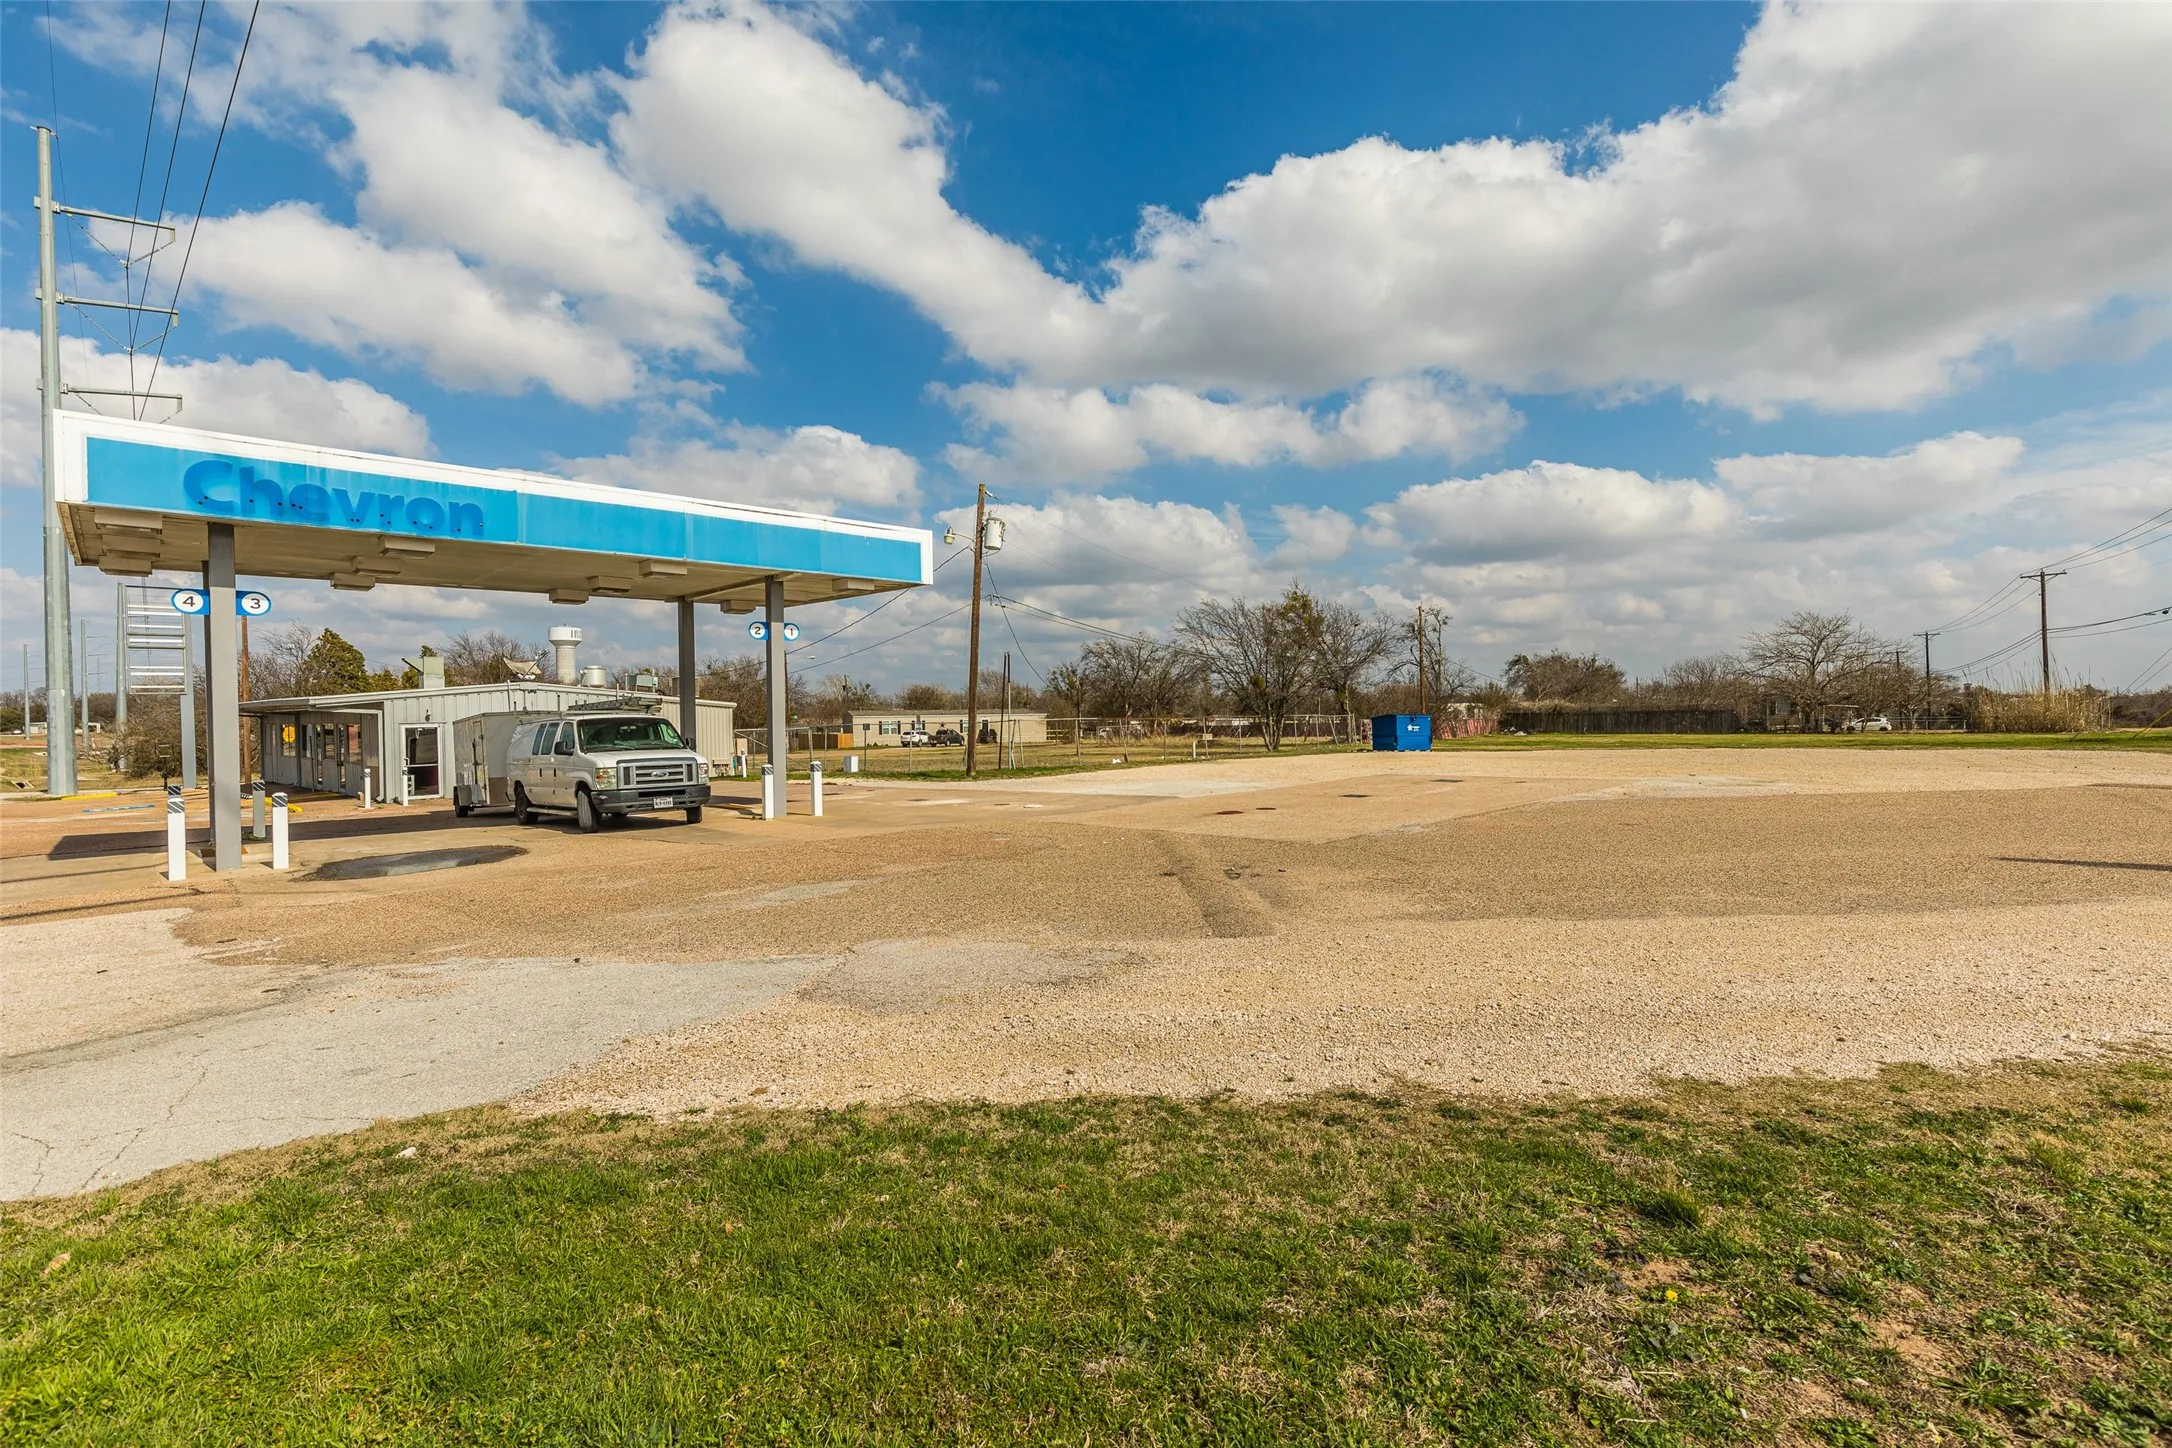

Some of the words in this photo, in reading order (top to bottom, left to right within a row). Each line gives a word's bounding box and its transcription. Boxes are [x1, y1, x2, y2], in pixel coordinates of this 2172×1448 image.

[183, 460, 484, 536] Chevron
[182, 596, 195, 607] 4
[250, 598, 261, 609] 3
[754, 626, 761, 635] 2
